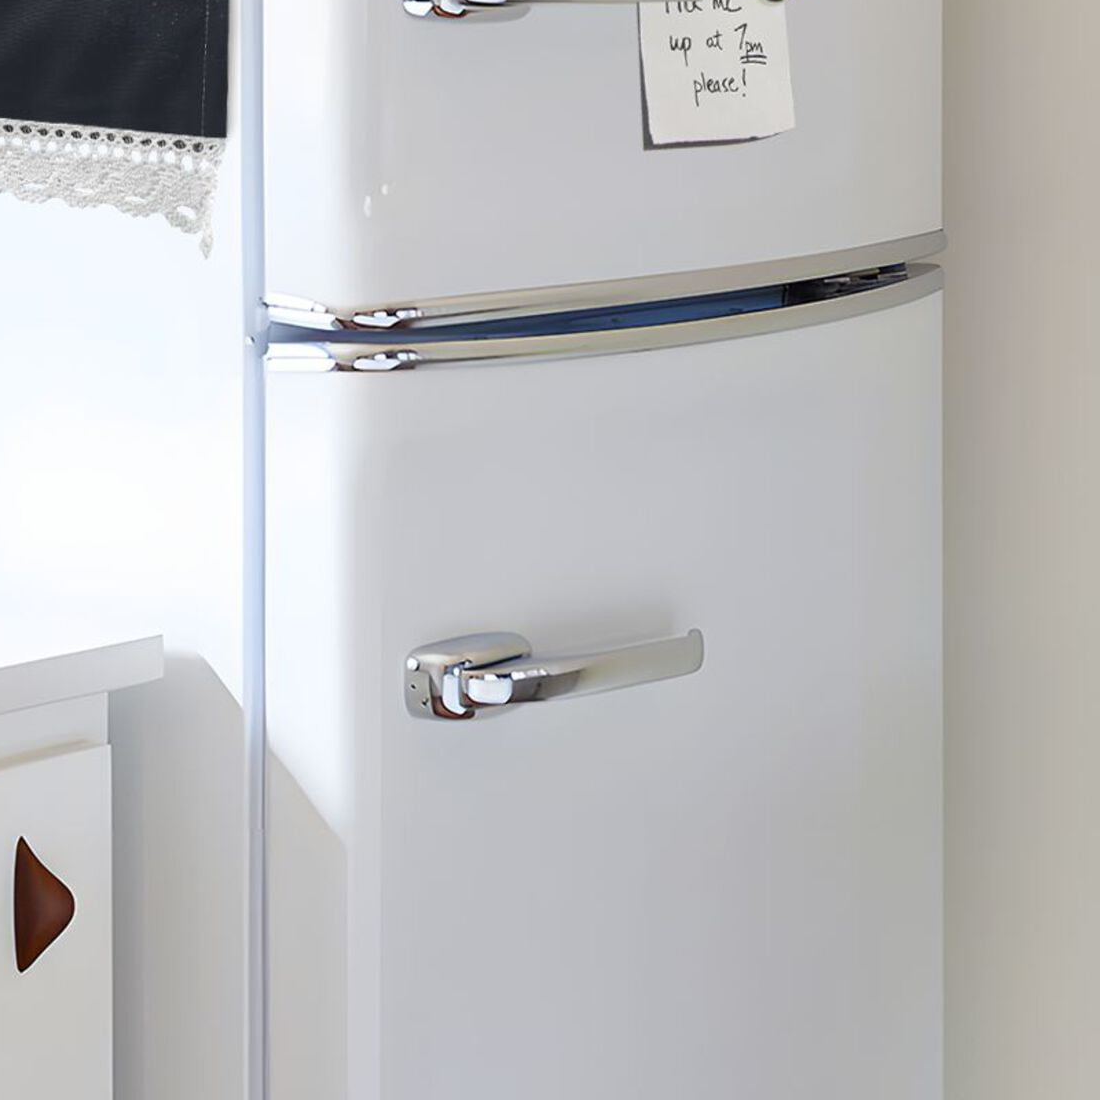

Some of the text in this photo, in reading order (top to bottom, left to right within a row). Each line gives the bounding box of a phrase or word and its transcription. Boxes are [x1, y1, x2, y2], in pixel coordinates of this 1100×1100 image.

[668, 34, 693, 67] up
[705, 29, 723, 51] at
[693, 68, 747, 108] please!
